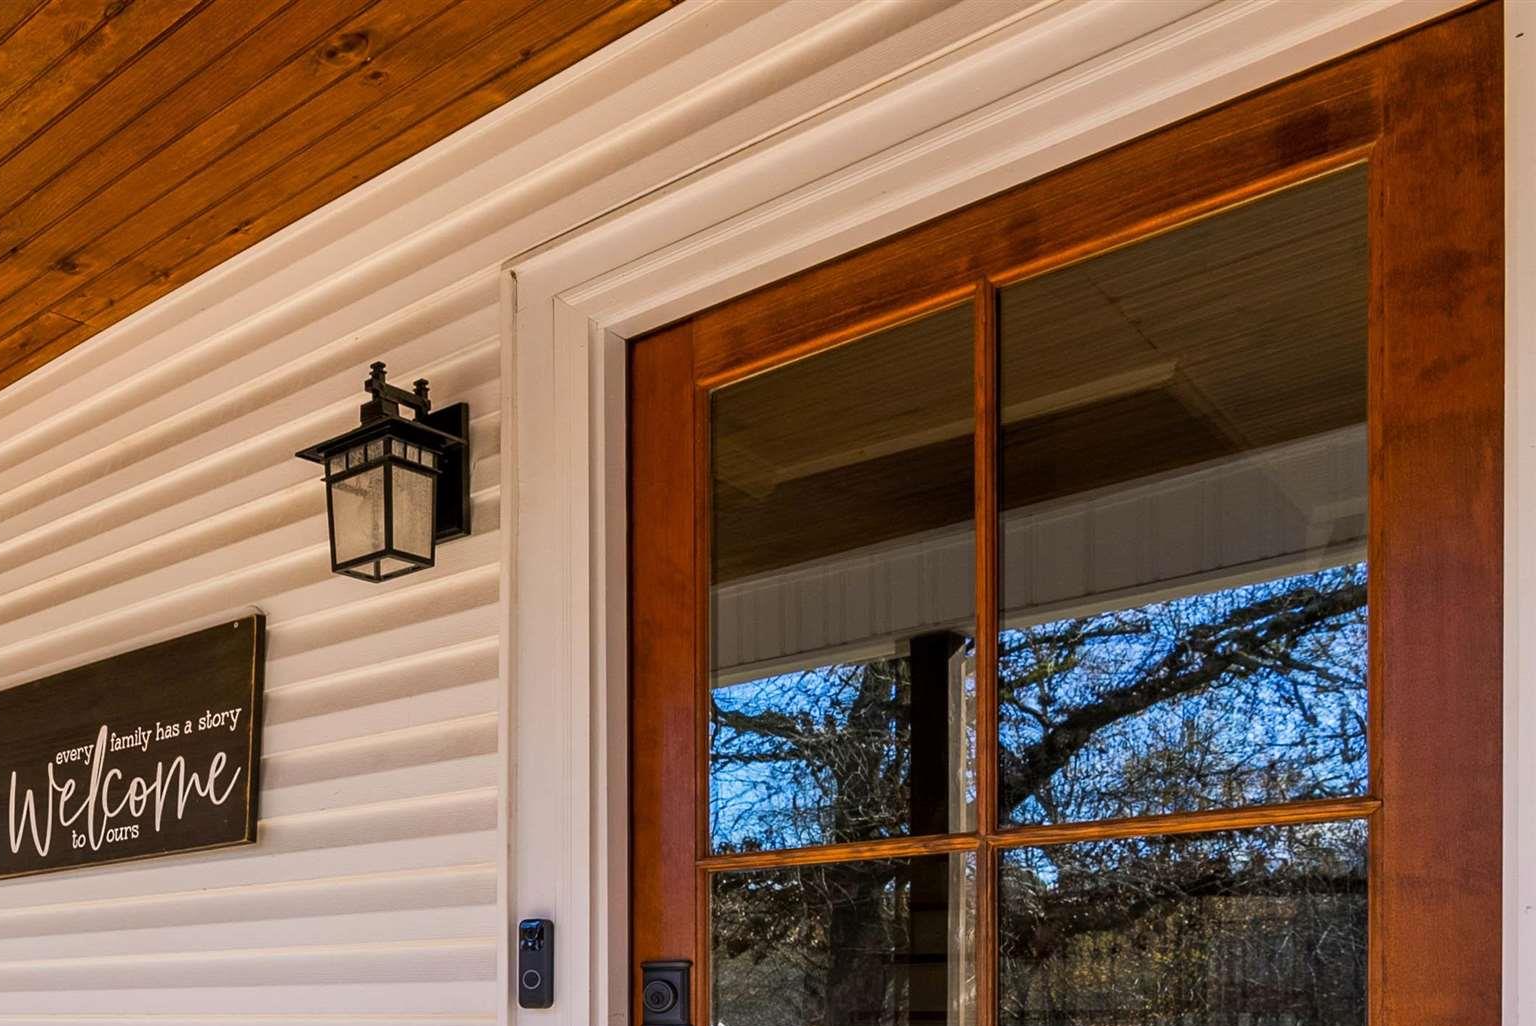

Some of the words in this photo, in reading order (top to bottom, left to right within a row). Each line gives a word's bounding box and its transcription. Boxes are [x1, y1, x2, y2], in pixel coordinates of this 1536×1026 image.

[55, 744, 95, 765] every
[109, 727, 152, 752] family
[155, 720, 180, 741] has
[183, 720, 193, 734] a
[198, 707, 242, 731] story
[71, 829, 86, 850] to
[106, 823, 140, 843] ours
